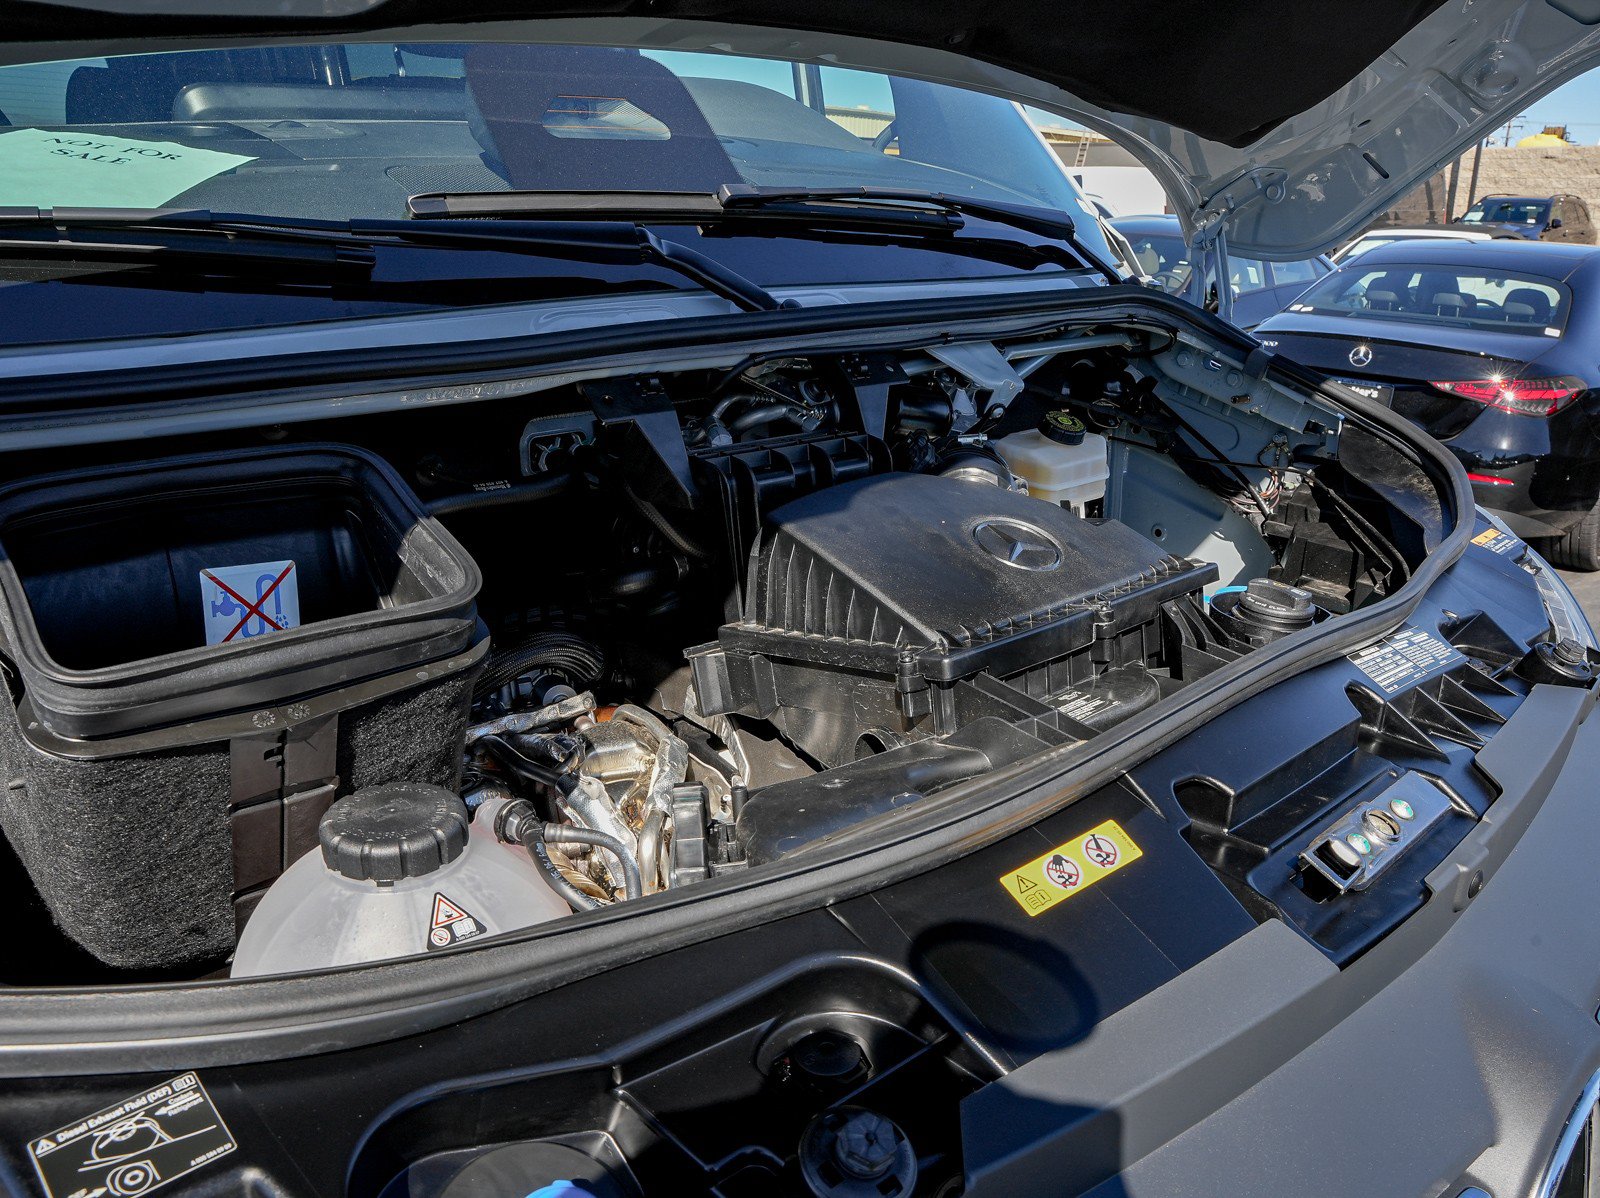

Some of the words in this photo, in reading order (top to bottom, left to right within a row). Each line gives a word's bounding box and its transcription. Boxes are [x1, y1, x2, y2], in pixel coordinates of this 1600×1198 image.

[44, 138, 114, 150] NOT
[120, 146, 182, 160] FOR
[50, 148, 132, 164] SALE
[56, 1122, 88, 1143] Diesel
[87, 1106, 125, 1129] Exhaust
[124, 1095, 148, 1113] Fluid
[147, 1085, 172, 1103] (DEF)
